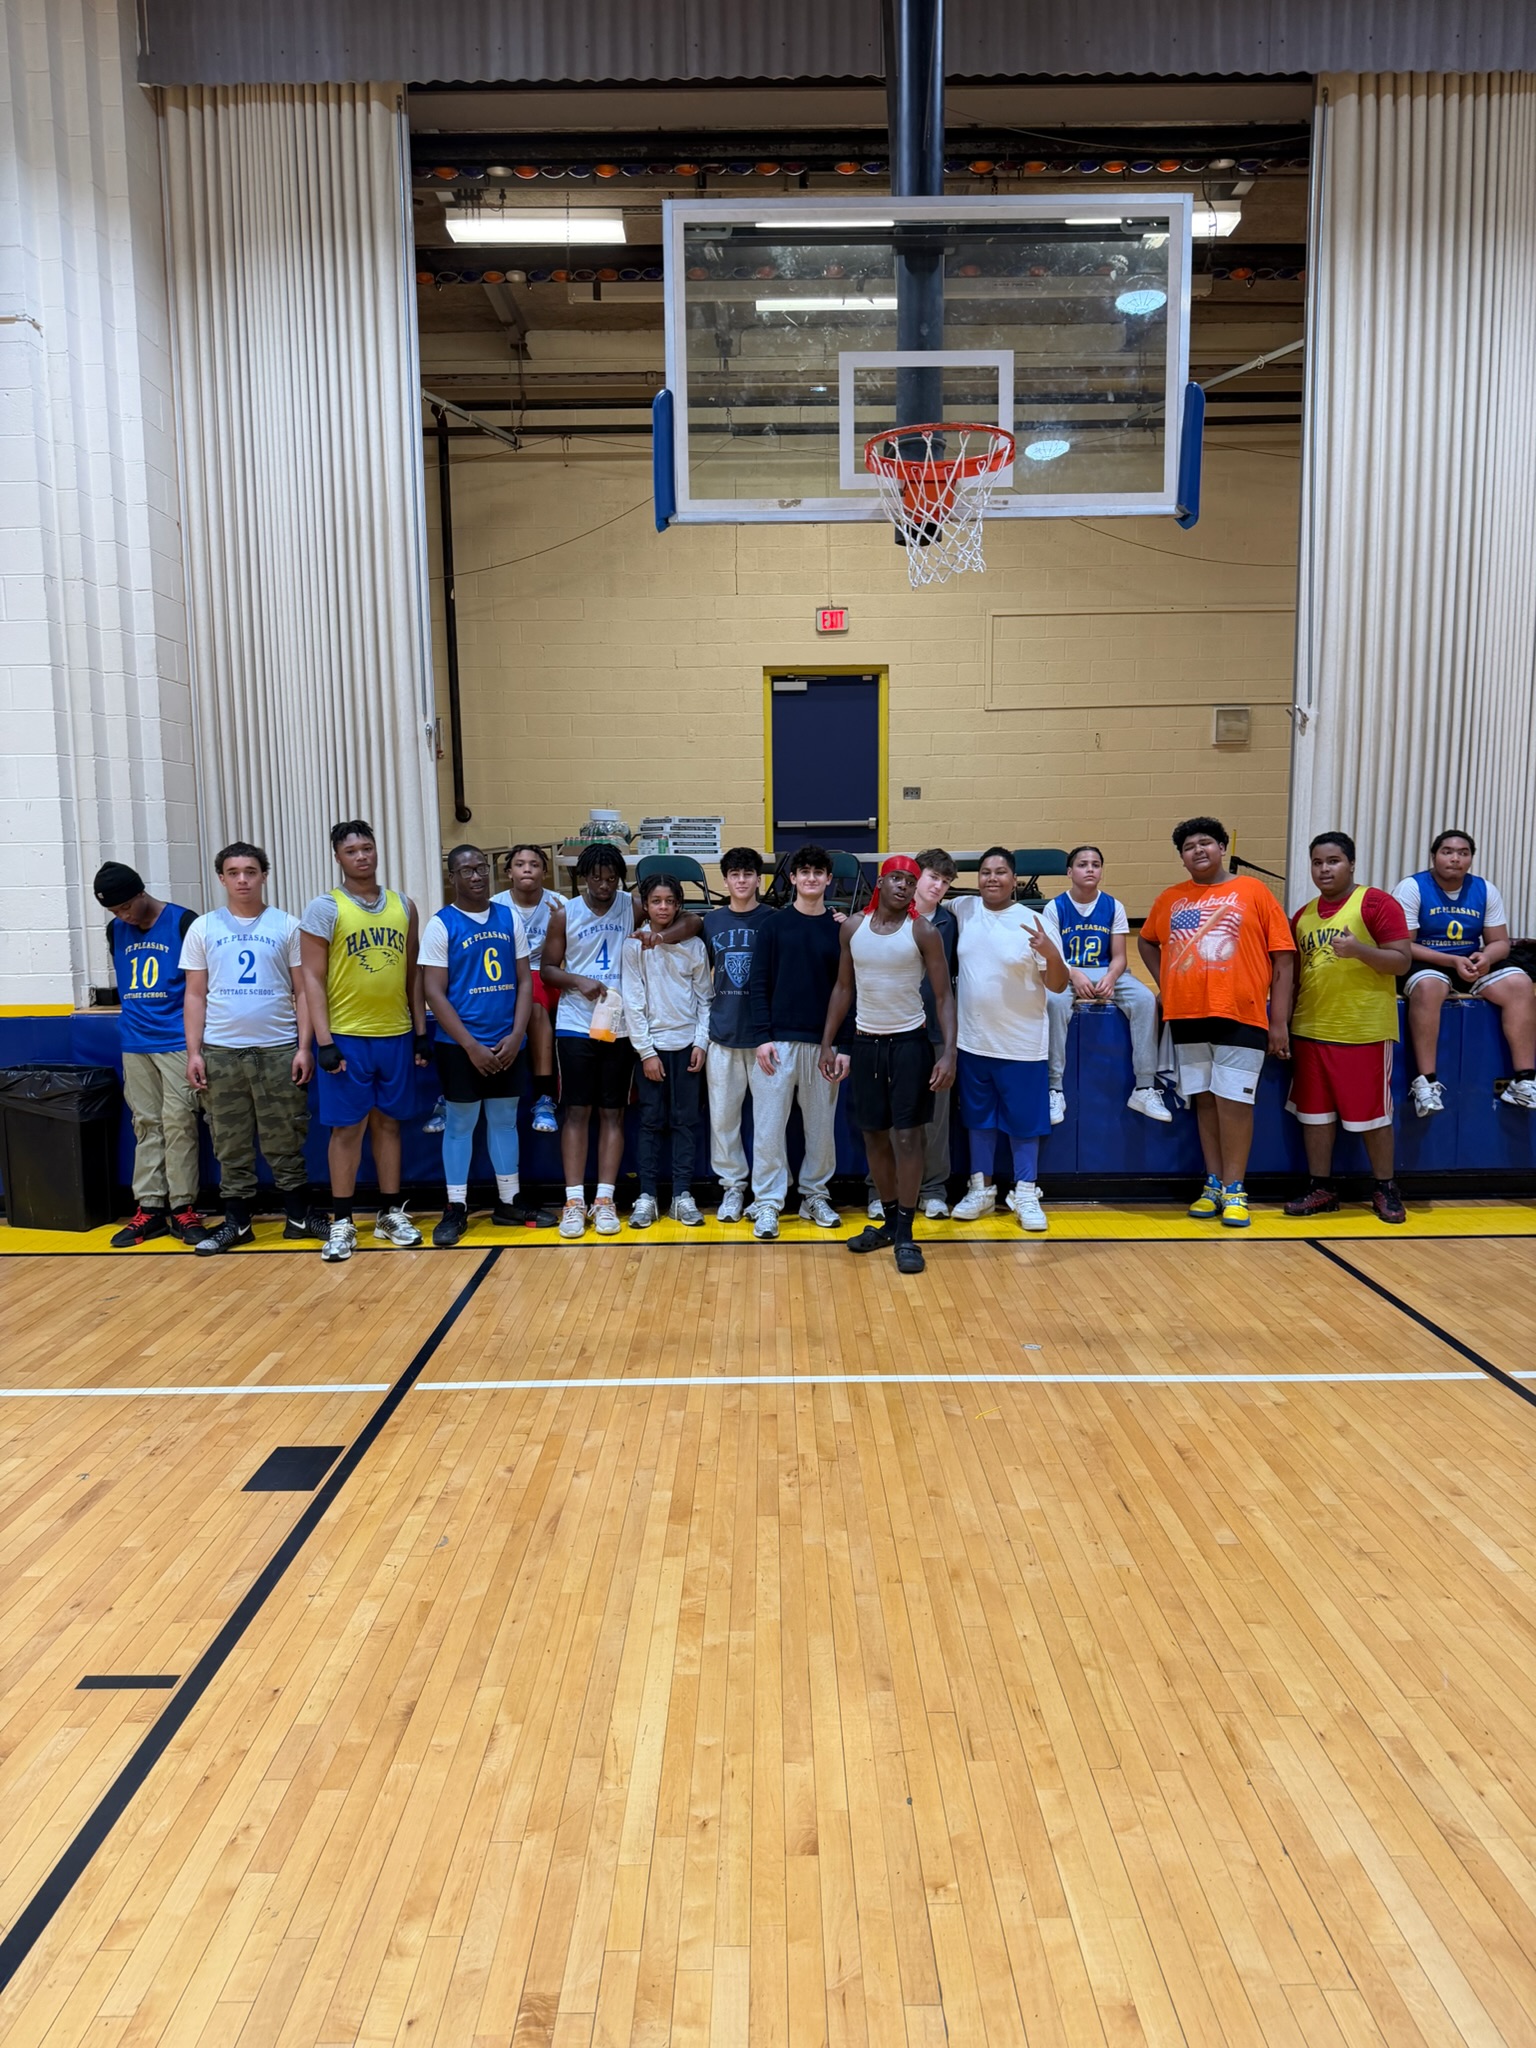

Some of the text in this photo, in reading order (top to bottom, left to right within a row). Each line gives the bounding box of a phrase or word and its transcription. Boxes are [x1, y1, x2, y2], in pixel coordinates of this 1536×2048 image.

[821, 610, 845, 630] EXIT
[1170, 891, 1242, 919] Baseball
[216, 933, 276, 947] MT. PLEASANT
[462, 930, 511, 949] MT. PLEASANT
[577, 928, 590, 941] MT.
[1061, 923, 1110, 936] MT. PLEASANT
[1300, 927, 1348, 954] HAWK
[133, 941, 170, 954] PLEASANT
[345, 926, 405, 957] HAWKS
[711, 928, 759, 955] KIT
[1065, 935, 1102, 967] 12
[483, 947, 502, 982] 6
[595, 938, 611, 971] 4
[129, 956, 159, 990] 10
[238, 949, 257, 985] 2
[142, 991, 168, 999] SCHOOL
[219, 988, 275, 996] COTTAGE SCHOOL
[468, 985, 497, 995] COTTAGE
